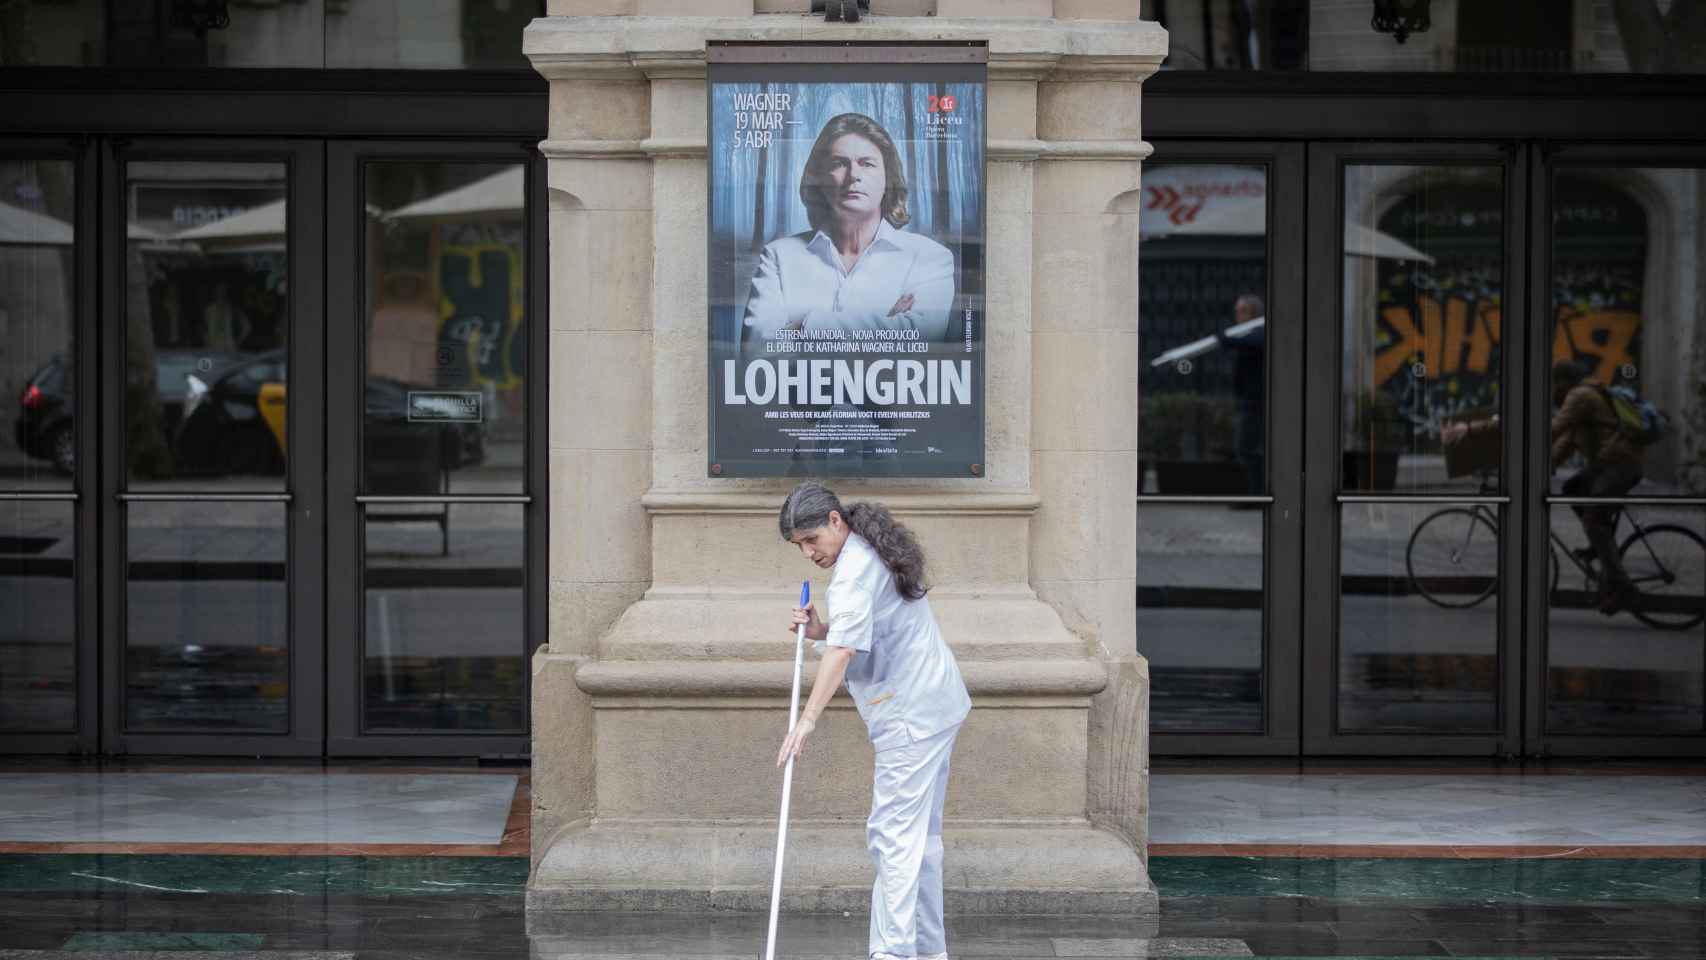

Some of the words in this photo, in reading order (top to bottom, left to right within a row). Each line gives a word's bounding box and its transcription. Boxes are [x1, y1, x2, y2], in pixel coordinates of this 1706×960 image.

[734, 92, 791, 111] WAGNER
[735, 112, 749, 129] 19
[752, 112, 783, 129] MAR
[927, 112, 963, 125] Liceu
[734, 130, 741, 148] 5
[745, 130, 773, 148] ABR
[775, 329, 808, 340] ESTRENA
[810, 329, 846, 340] MUNDIAL
[852, 329, 874, 340] NOVA
[875, 327, 920, 340] PRODUCCIÓ
[766, 342, 776, 353] EL
[777, 342, 802, 353] DEBUT
[803, 342, 815, 353] DE
[816, 342, 861, 353] KATHARINA
[861, 342, 895, 353] WAGNER
[896, 342, 906, 353] AL
[907, 342, 929, 353] LICEU
[724, 359, 972, 405] LOHENGRIN
[805, 411, 813, 419] DE
[814, 411, 832, 419] KLAUS
[832, 411, 857, 419] FLORIAN
[858, 411, 873, 419] VOGT
[877, 411, 898, 419] EVELYN
